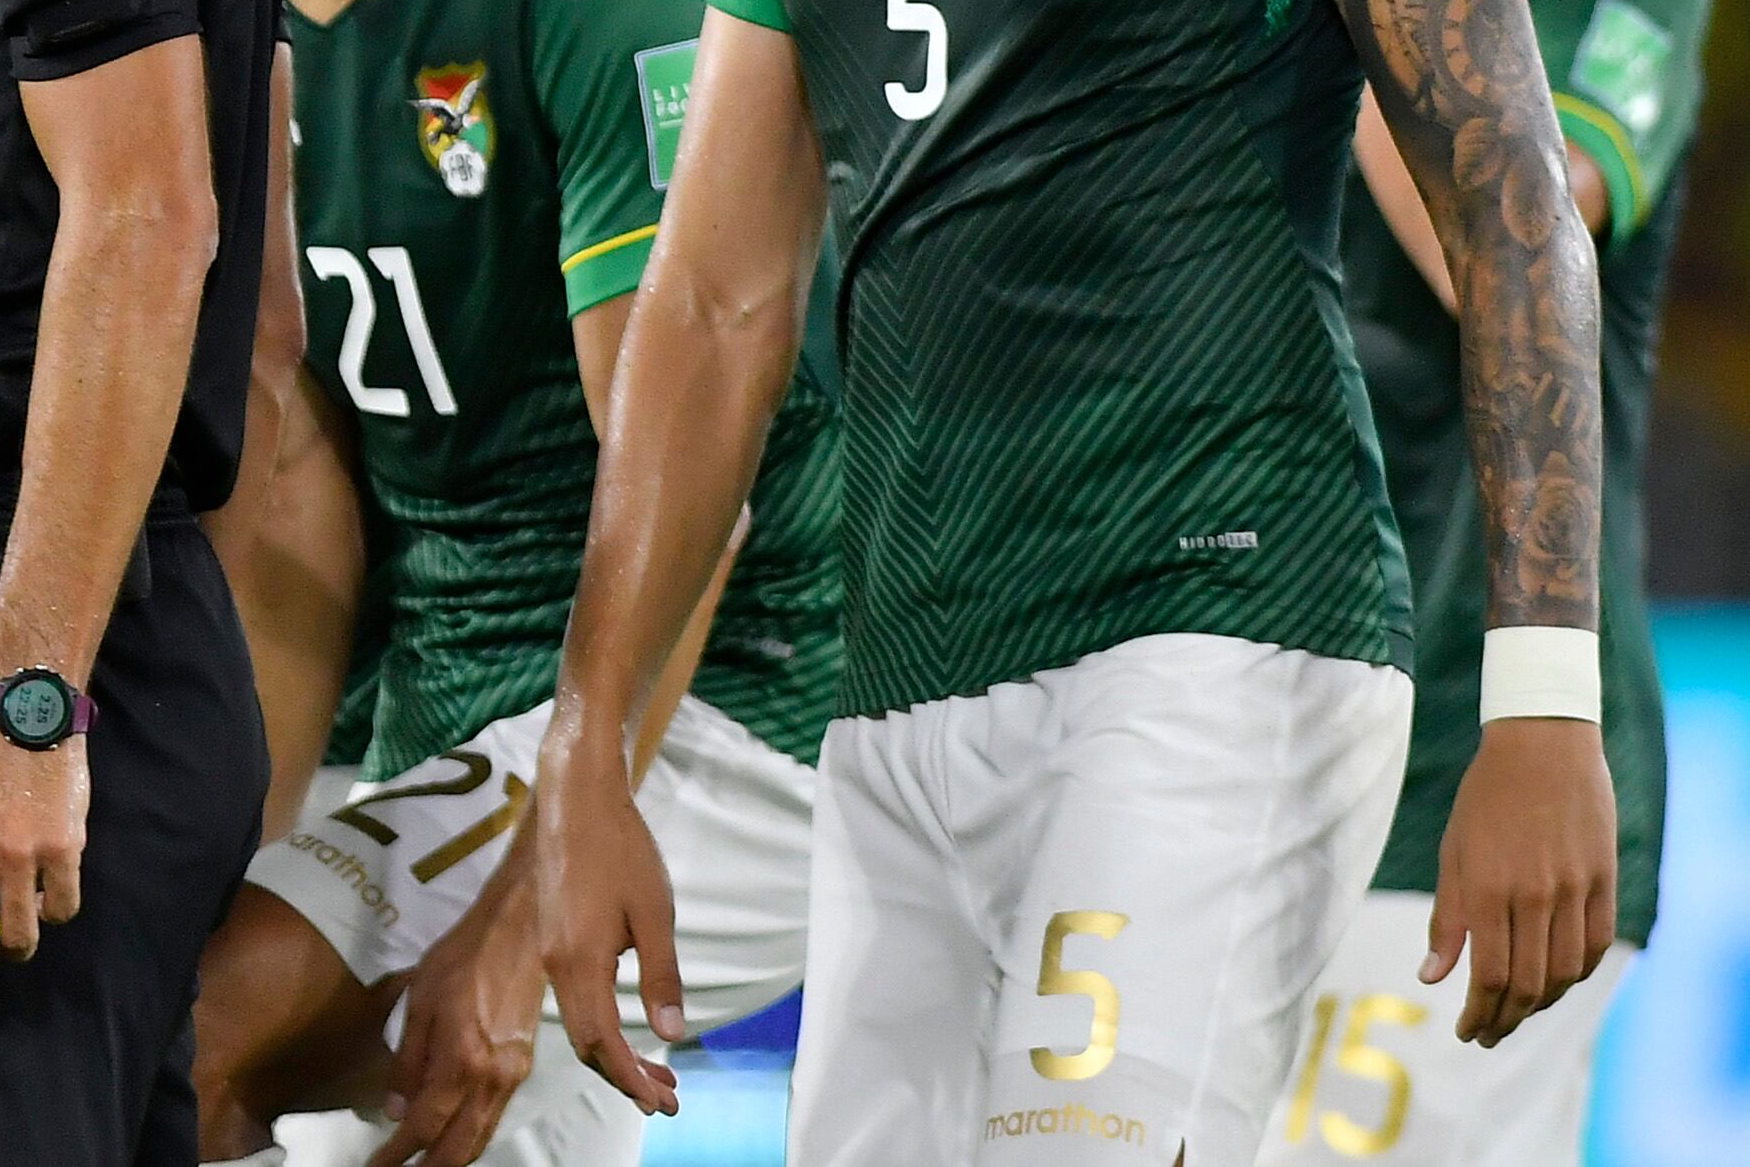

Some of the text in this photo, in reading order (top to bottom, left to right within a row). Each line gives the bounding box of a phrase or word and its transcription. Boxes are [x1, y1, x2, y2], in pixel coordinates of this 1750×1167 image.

[306, 246, 459, 418] 21
[289, 830, 401, 929] arathon
[327, 749, 529, 884] 21
[1029, 909, 1132, 1081] 5
[985, 1101, 1147, 1148] marathon
[1285, 994, 1430, 1159] 15
